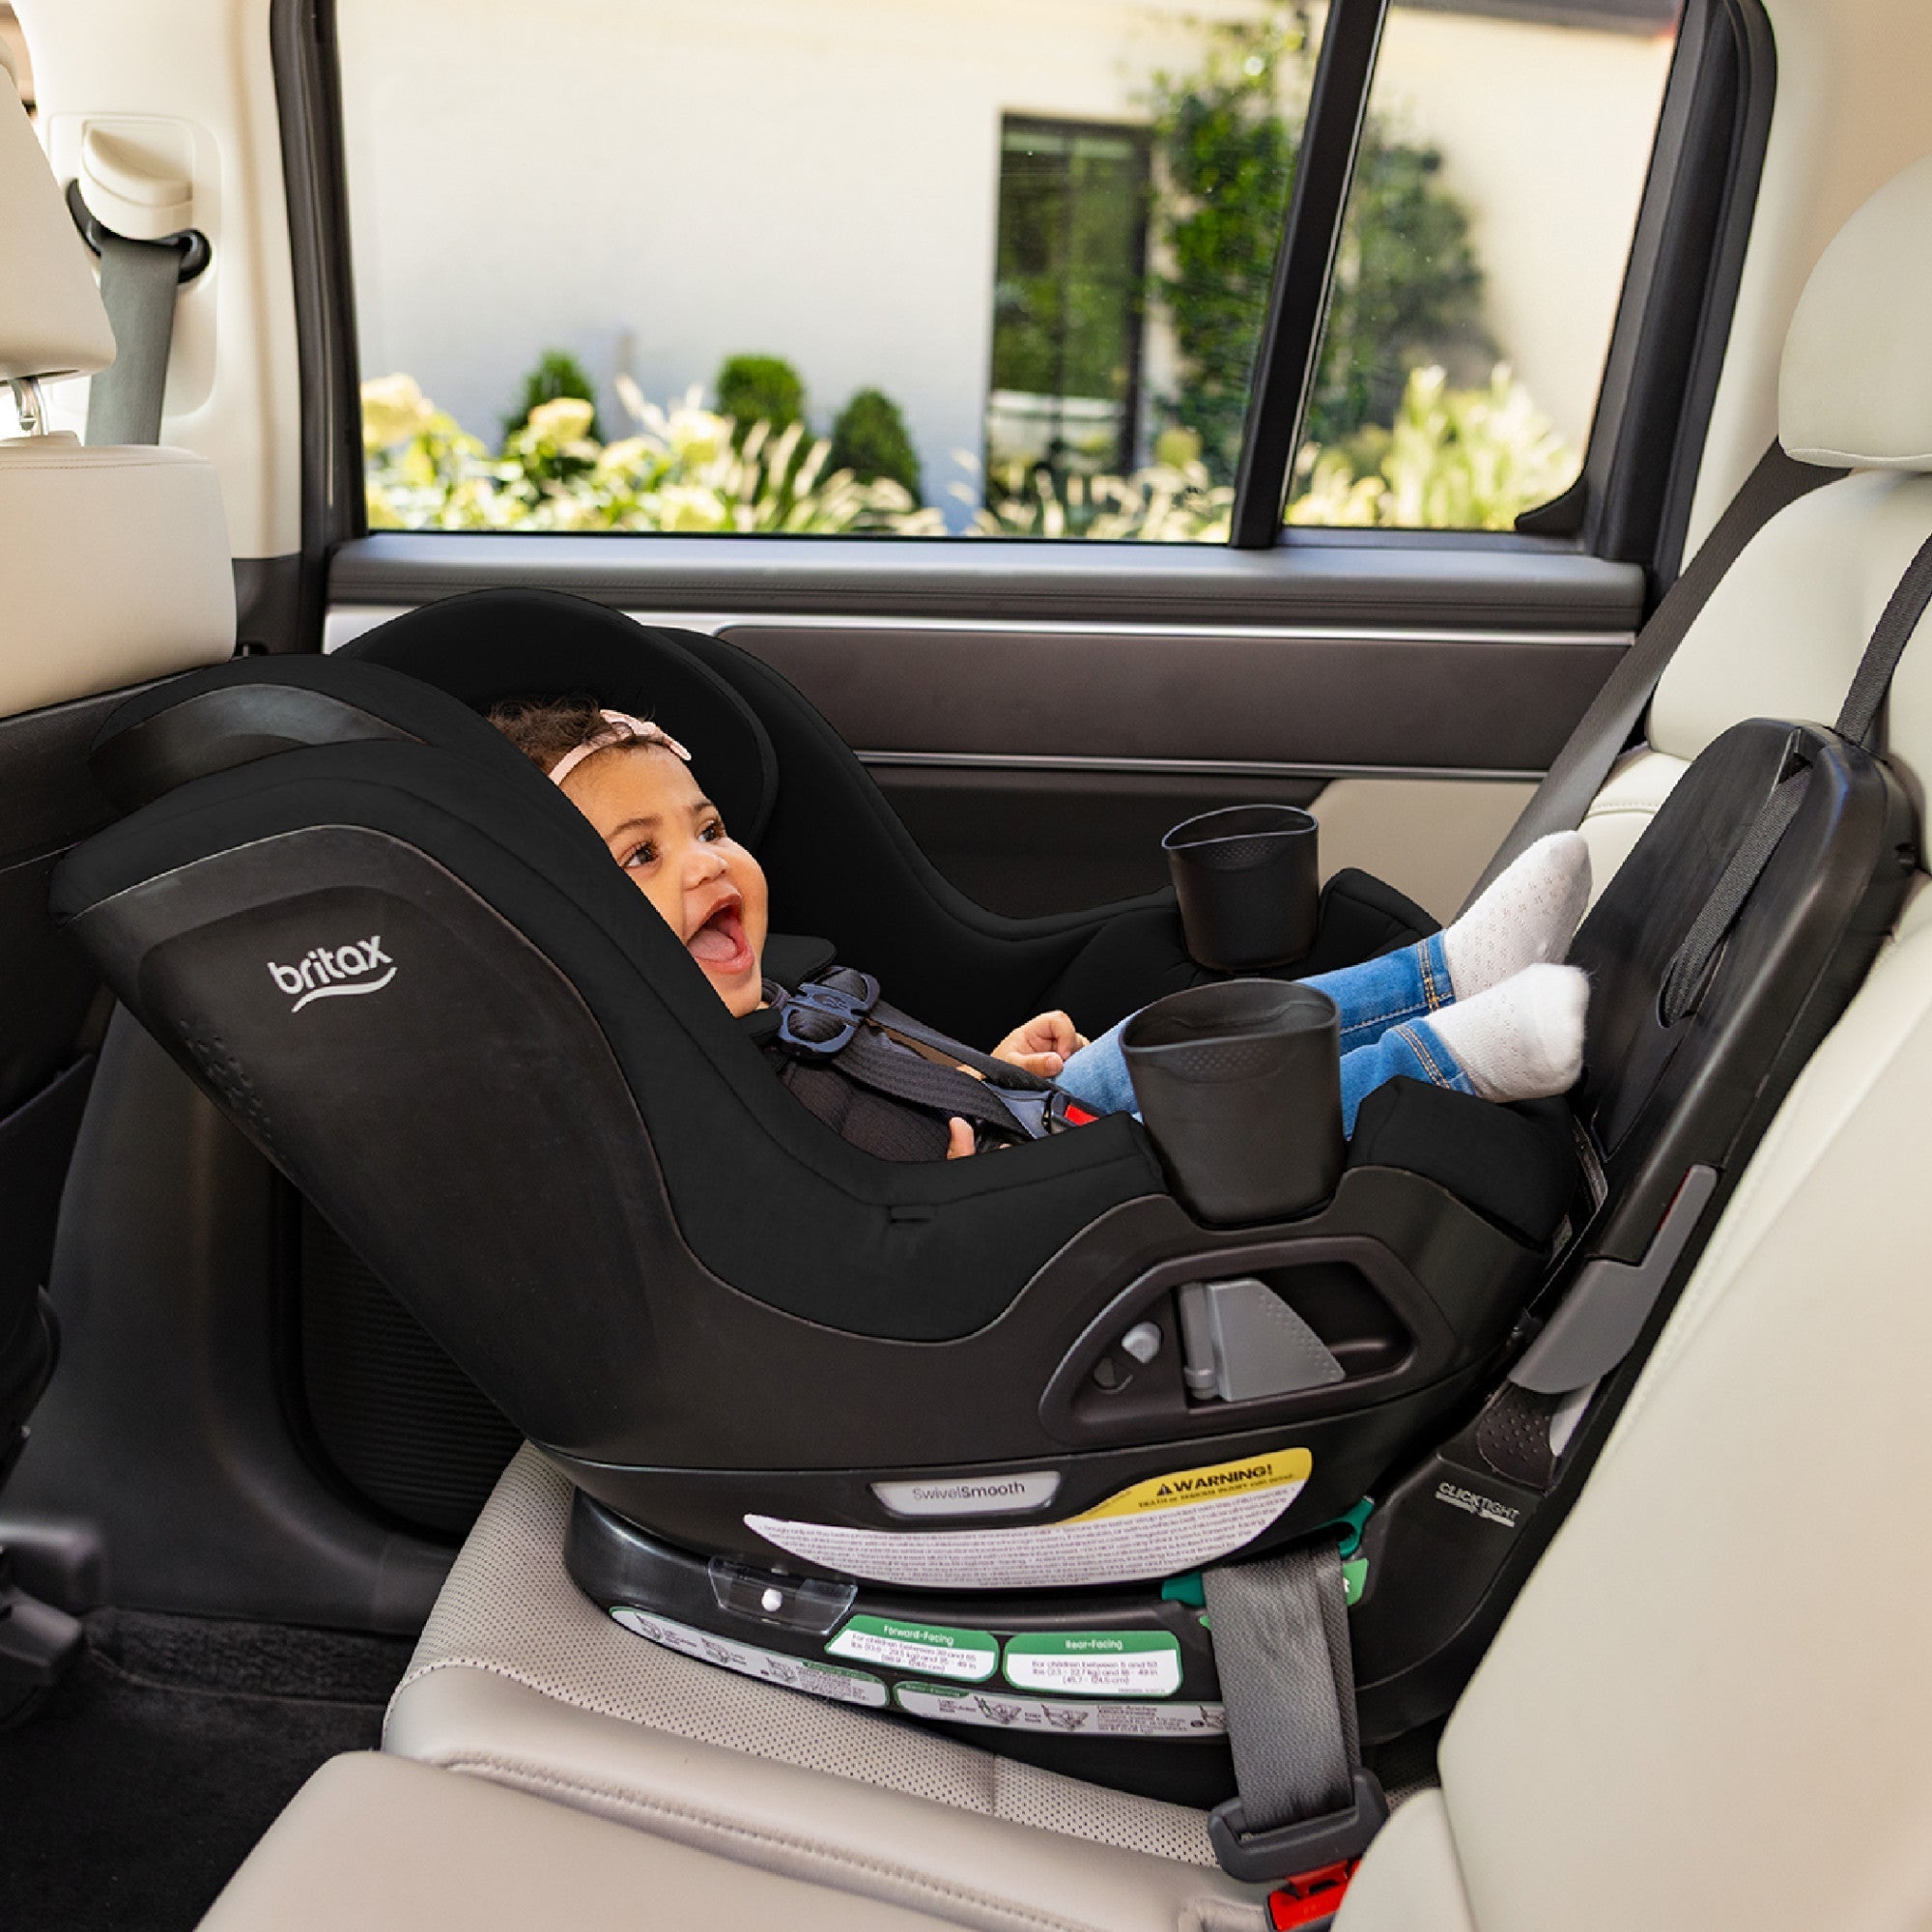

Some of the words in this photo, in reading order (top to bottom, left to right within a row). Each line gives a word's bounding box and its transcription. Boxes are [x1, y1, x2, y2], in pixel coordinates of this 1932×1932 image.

[268, 935, 393, 994] britax
[912, 1481, 1025, 1500] SwivelSmooth
[1174, 1463, 1273, 1492] WARNING!
[1438, 1482, 1520, 1521] CLICKTIGHT
[884, 1625, 954, 1648] Forward-Facing
[1065, 1639, 1123, 1651] Rear-Facing
